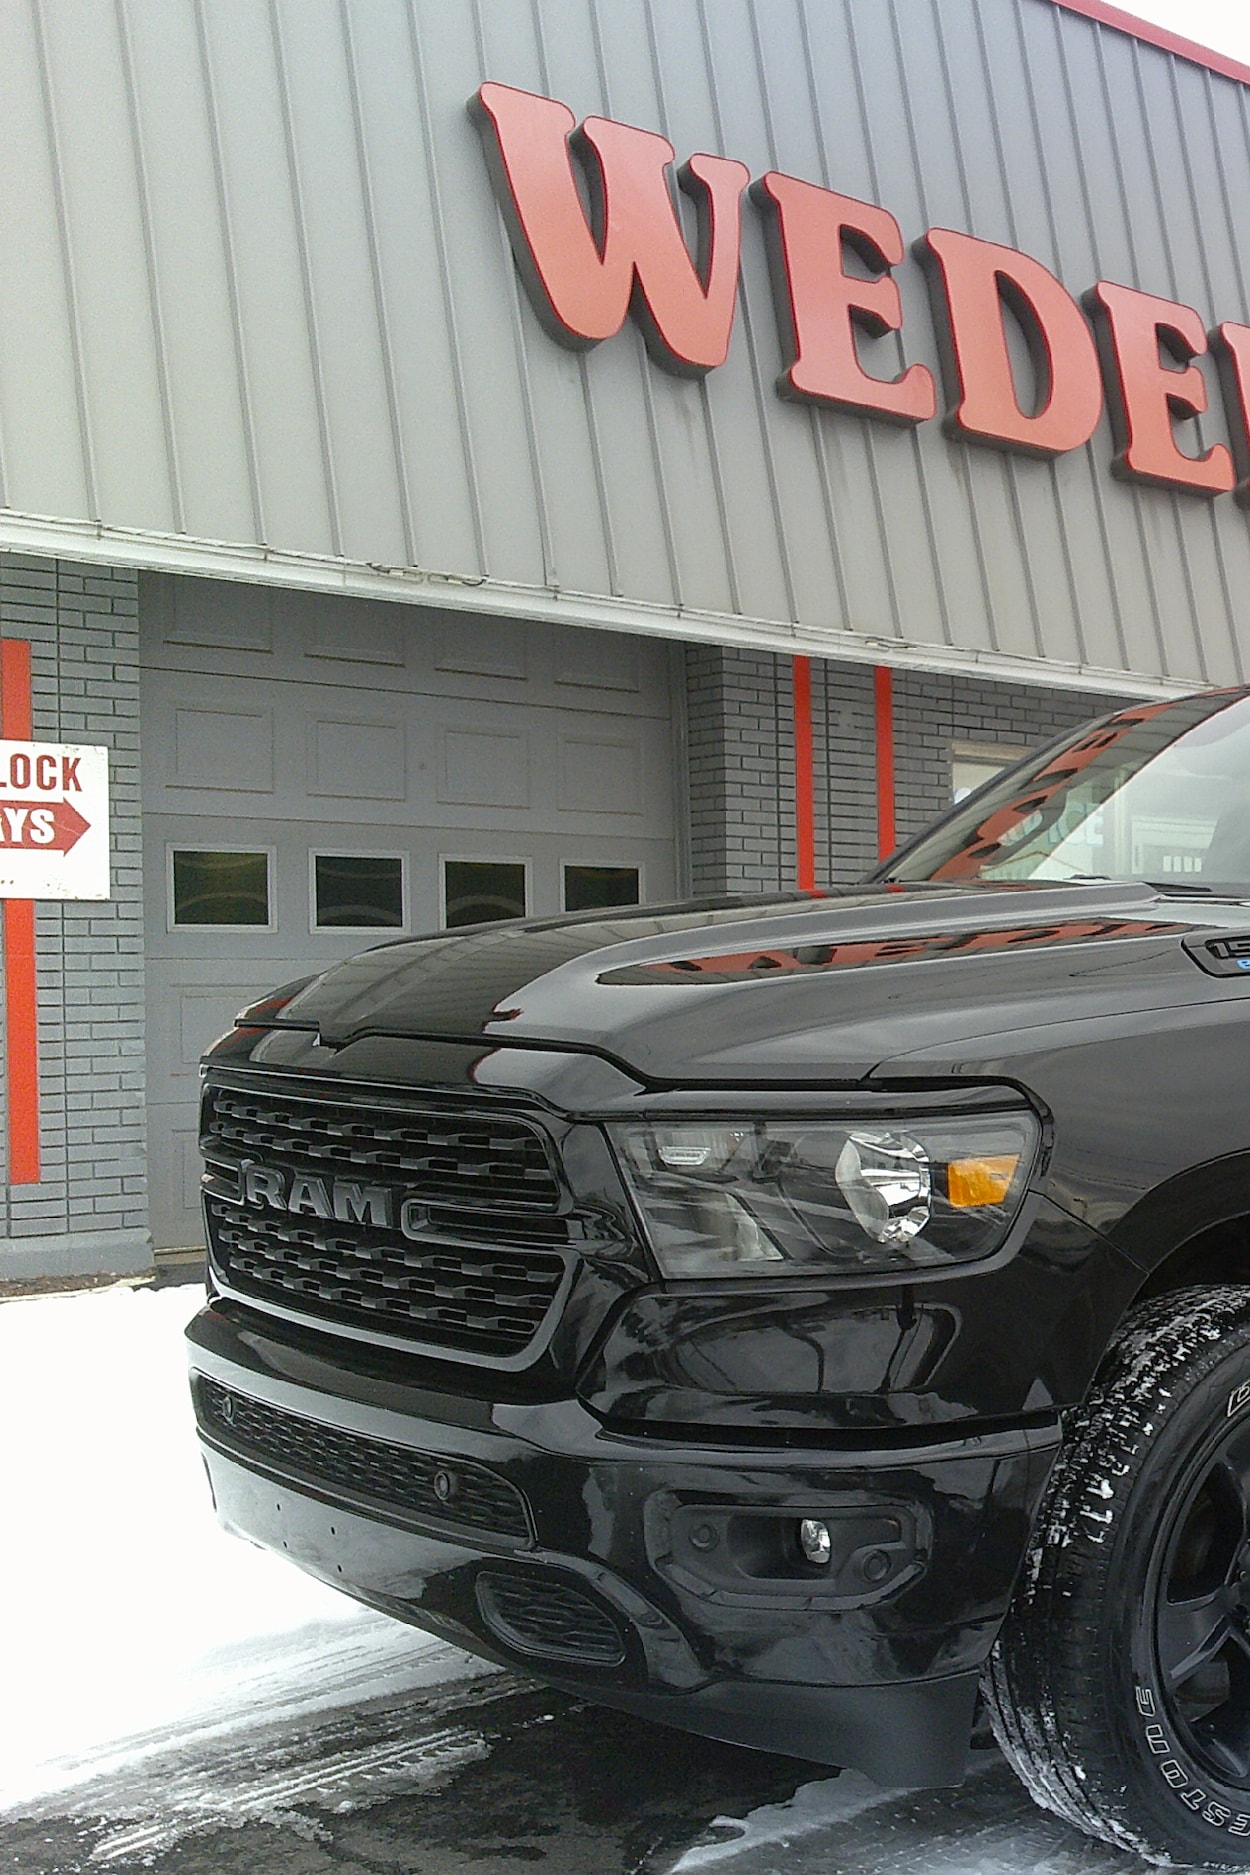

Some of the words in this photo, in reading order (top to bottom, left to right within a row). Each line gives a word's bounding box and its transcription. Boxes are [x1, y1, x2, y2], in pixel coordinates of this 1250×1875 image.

[0, 753, 83, 792] OCK
[0, 807, 55, 844] YS
[244, 1163, 393, 1228] RAM
